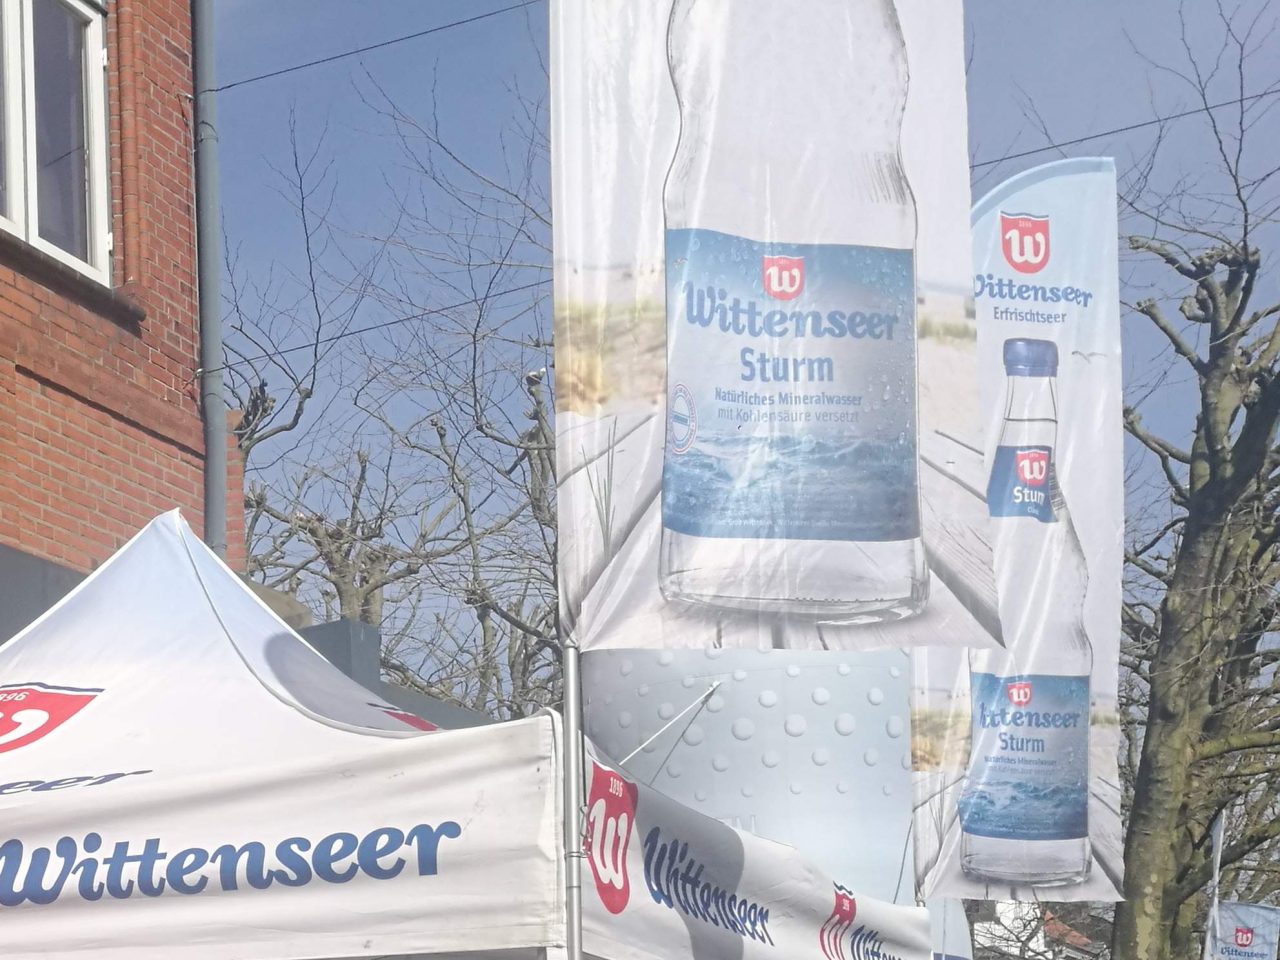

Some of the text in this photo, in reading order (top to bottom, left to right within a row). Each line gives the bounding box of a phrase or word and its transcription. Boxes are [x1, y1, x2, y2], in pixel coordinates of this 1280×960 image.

[683, 280, 900, 341] Wittenseer
[993, 306, 1068, 324] Erfrischtseer
[739, 346, 834, 383] Sturm
[714, 387, 863, 407] Natürliches Mineralwasser
[718, 407, 734, 421] mit
[735, 406, 811, 423] Kohlensäure
[998, 732, 1045, 753] Sturm
[643, 825, 776, 948] Wittenseer
